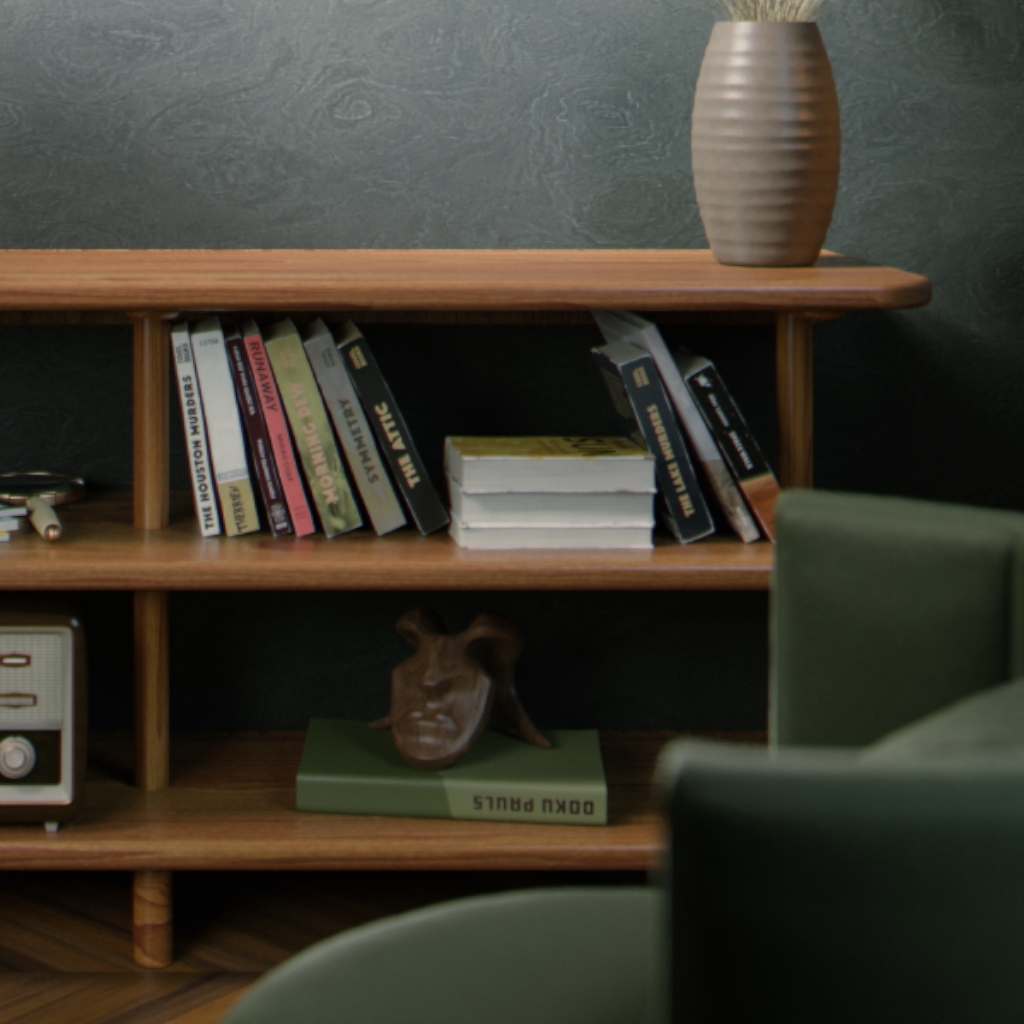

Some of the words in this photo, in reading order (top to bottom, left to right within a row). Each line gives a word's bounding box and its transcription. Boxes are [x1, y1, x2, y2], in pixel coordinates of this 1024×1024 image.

[249, 341, 278, 412] RUNAWAY
[288, 382, 311, 419] DEW
[182, 375, 198, 436] MURDERS
[374, 401, 407, 451] ATTIC
[338, 398, 380, 484] SYMMETRY
[647, 404, 675, 462] MURDERS
[191, 440, 209, 502] HOUSTON
[302, 424, 340, 505] MORNING
[397, 453, 421, 490] THE
[202, 502, 214, 530] THE
[679, 492, 695, 518] THE
[473, 795, 534, 812] PAULS
[542, 798, 595, 815] DOKU
